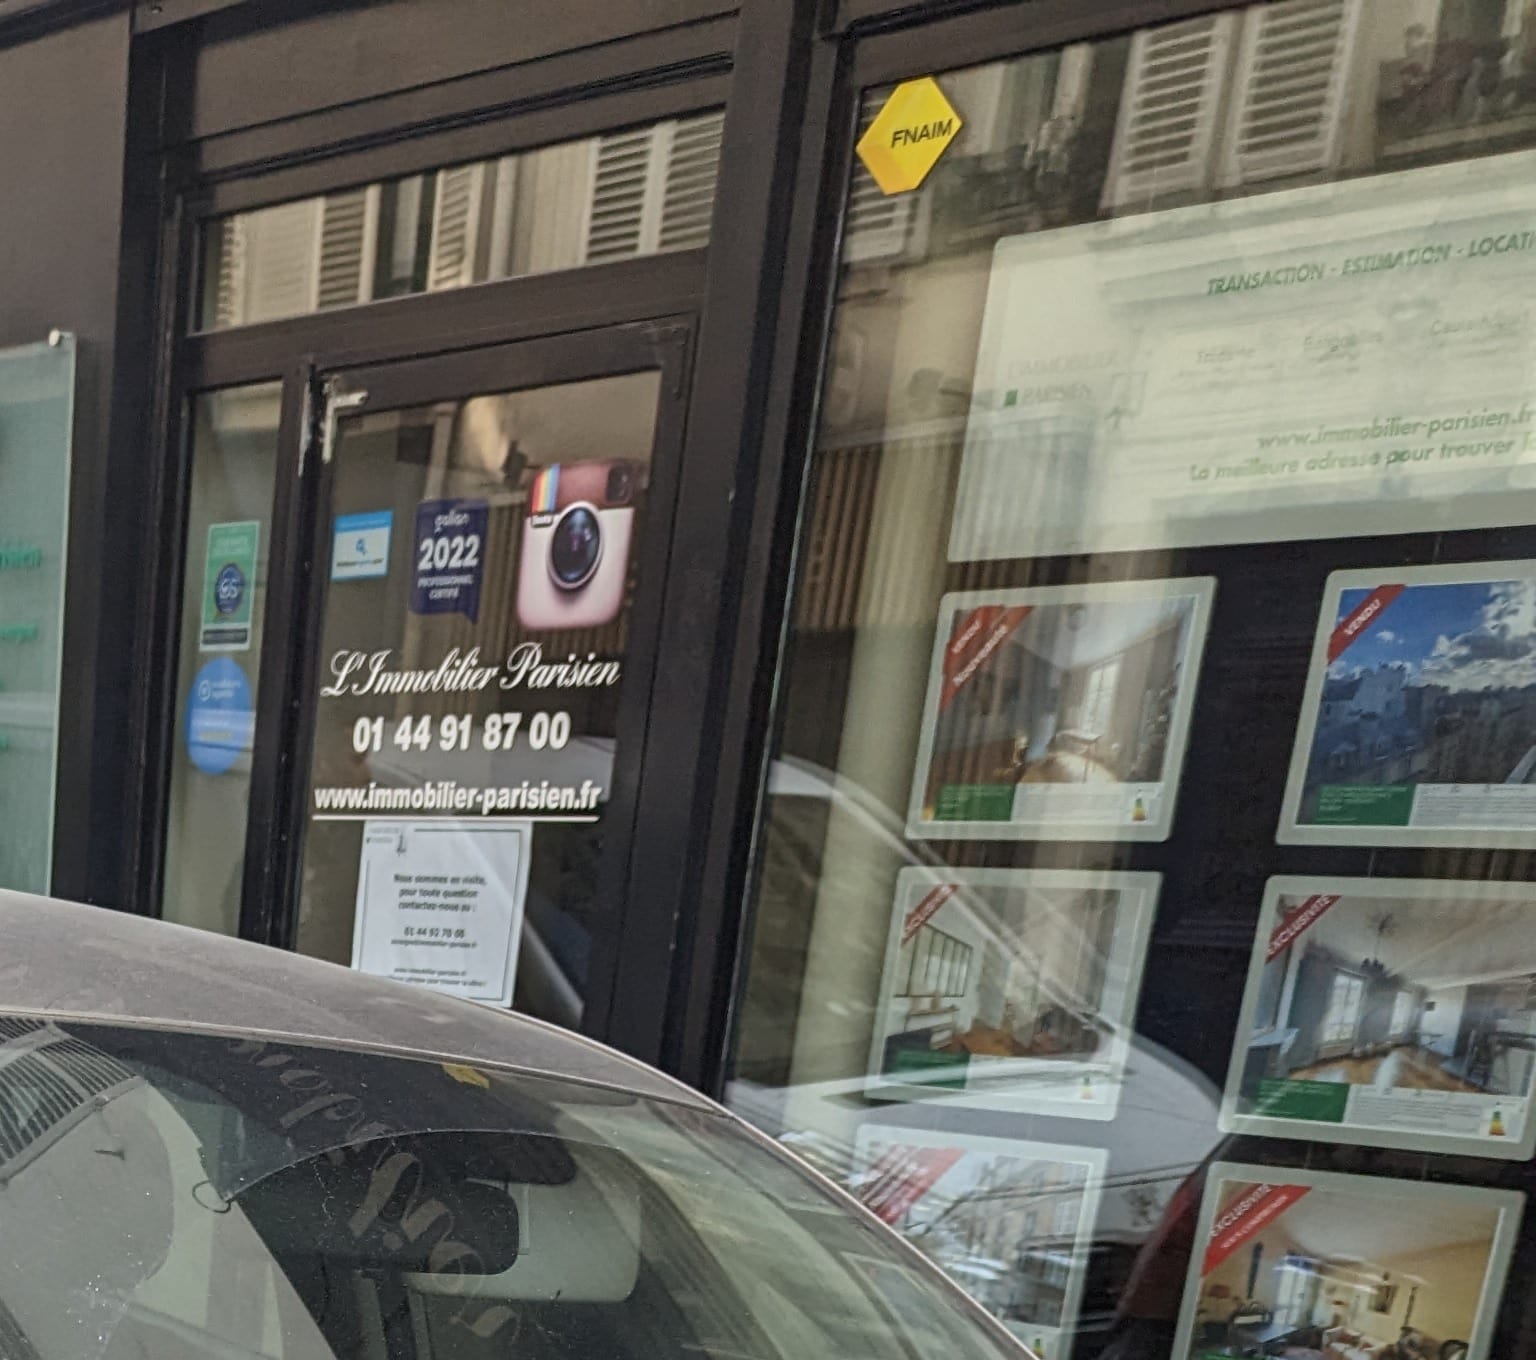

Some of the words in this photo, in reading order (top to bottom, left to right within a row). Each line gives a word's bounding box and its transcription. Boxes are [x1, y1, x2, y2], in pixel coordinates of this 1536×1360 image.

[891, 118, 953, 149] FNAIM
[1207, 263, 1326, 296] TRANSACTION
[1341, 243, 1453, 276] ESTIMATION
[1215, 456, 1300, 482] meilleure
[1304, 448, 1381, 473] adresse
[1384, 447, 1434, 468] pour
[1439, 437, 1518, 460] trouver
[417, 534, 480, 571] 2022
[1344, 598, 1382, 637] VENDU
[320, 646, 499, 697] L'Immobilier
[500, 642, 621, 690] Parisien
[352, 716, 385, 753] 01
[393, 714, 432, 753] 44
[439, 713, 473, 751] 91
[482, 711, 522, 751] 87
[529, 711, 571, 750] 00
[314, 779, 603, 816] www.immobilier-parisien.fr
